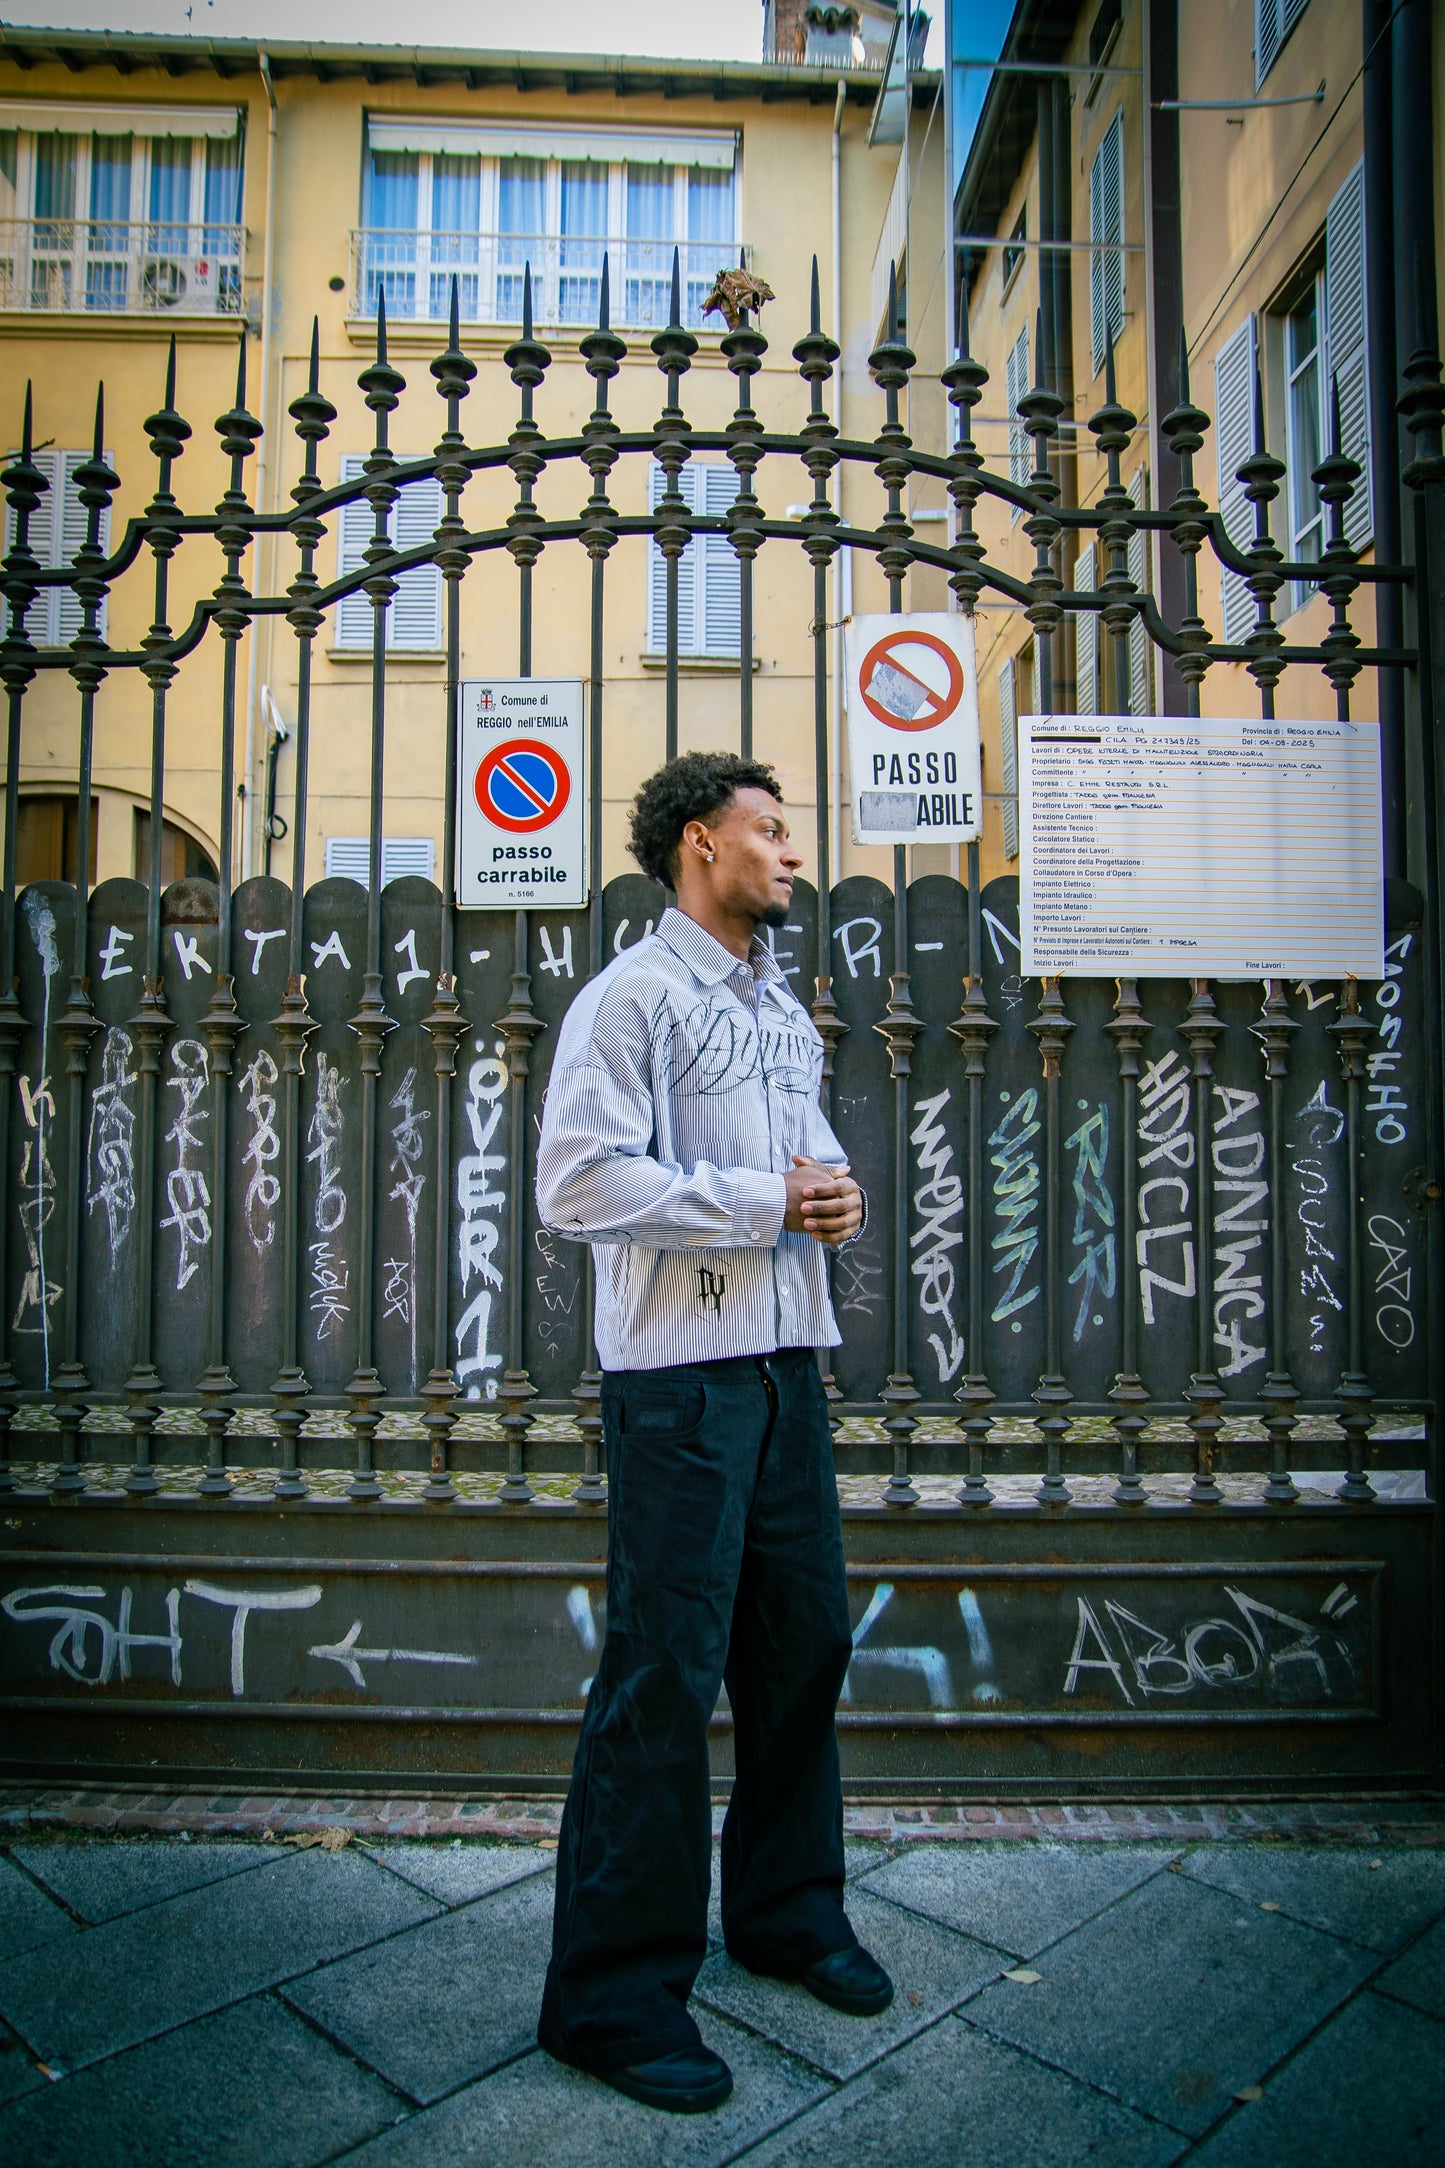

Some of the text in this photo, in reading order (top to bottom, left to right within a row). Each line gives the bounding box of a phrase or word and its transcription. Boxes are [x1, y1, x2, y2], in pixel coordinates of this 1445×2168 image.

[501, 695, 548, 706] Comune di
[477, 716, 568, 729] REGGIO nell'EMILIA
[1074, 725, 1110, 733] REGGIO
[1066, 747, 1094, 755] OPERE
[1032, 758, 1071, 767] Proprietario
[873, 752, 957, 785] PASSO
[1032, 769, 1074, 777] Committente
[1032, 781, 1059, 789] Impresa
[1032, 792, 1068, 800] Progettista
[1032, 802, 1061, 810] Direttore
[1032, 813, 1064, 821] Direzione
[1072, 836, 1095, 844] Statico
[493, 846, 552, 862] passo
[1032, 847, 1076, 855] Coordinatore
[1032, 858, 1076, 866] Coordinatore
[1095, 859, 1141, 868] Progettazione
[477, 867, 567, 883] carrabile
[1033, 869, 1076, 877] Collaudatore
[1033, 881, 1062, 889] Impianto
[1063, 881, 1091, 889] Elettrico
[1033, 892, 1062, 900] Impianto
[1063, 892, 1093, 900] Idraulico
[1033, 903, 1063, 912] Impianto
[1033, 914, 1059, 923] Importo
[1074, 926, 1107, 934] Lavoratori
[1133, 938, 1150, 946] Cantiere
[1033, 948, 1078, 957] Responsabile
[1097, 949, 1129, 957] Sicurezza
[1245, 961, 1260, 969] Fine
